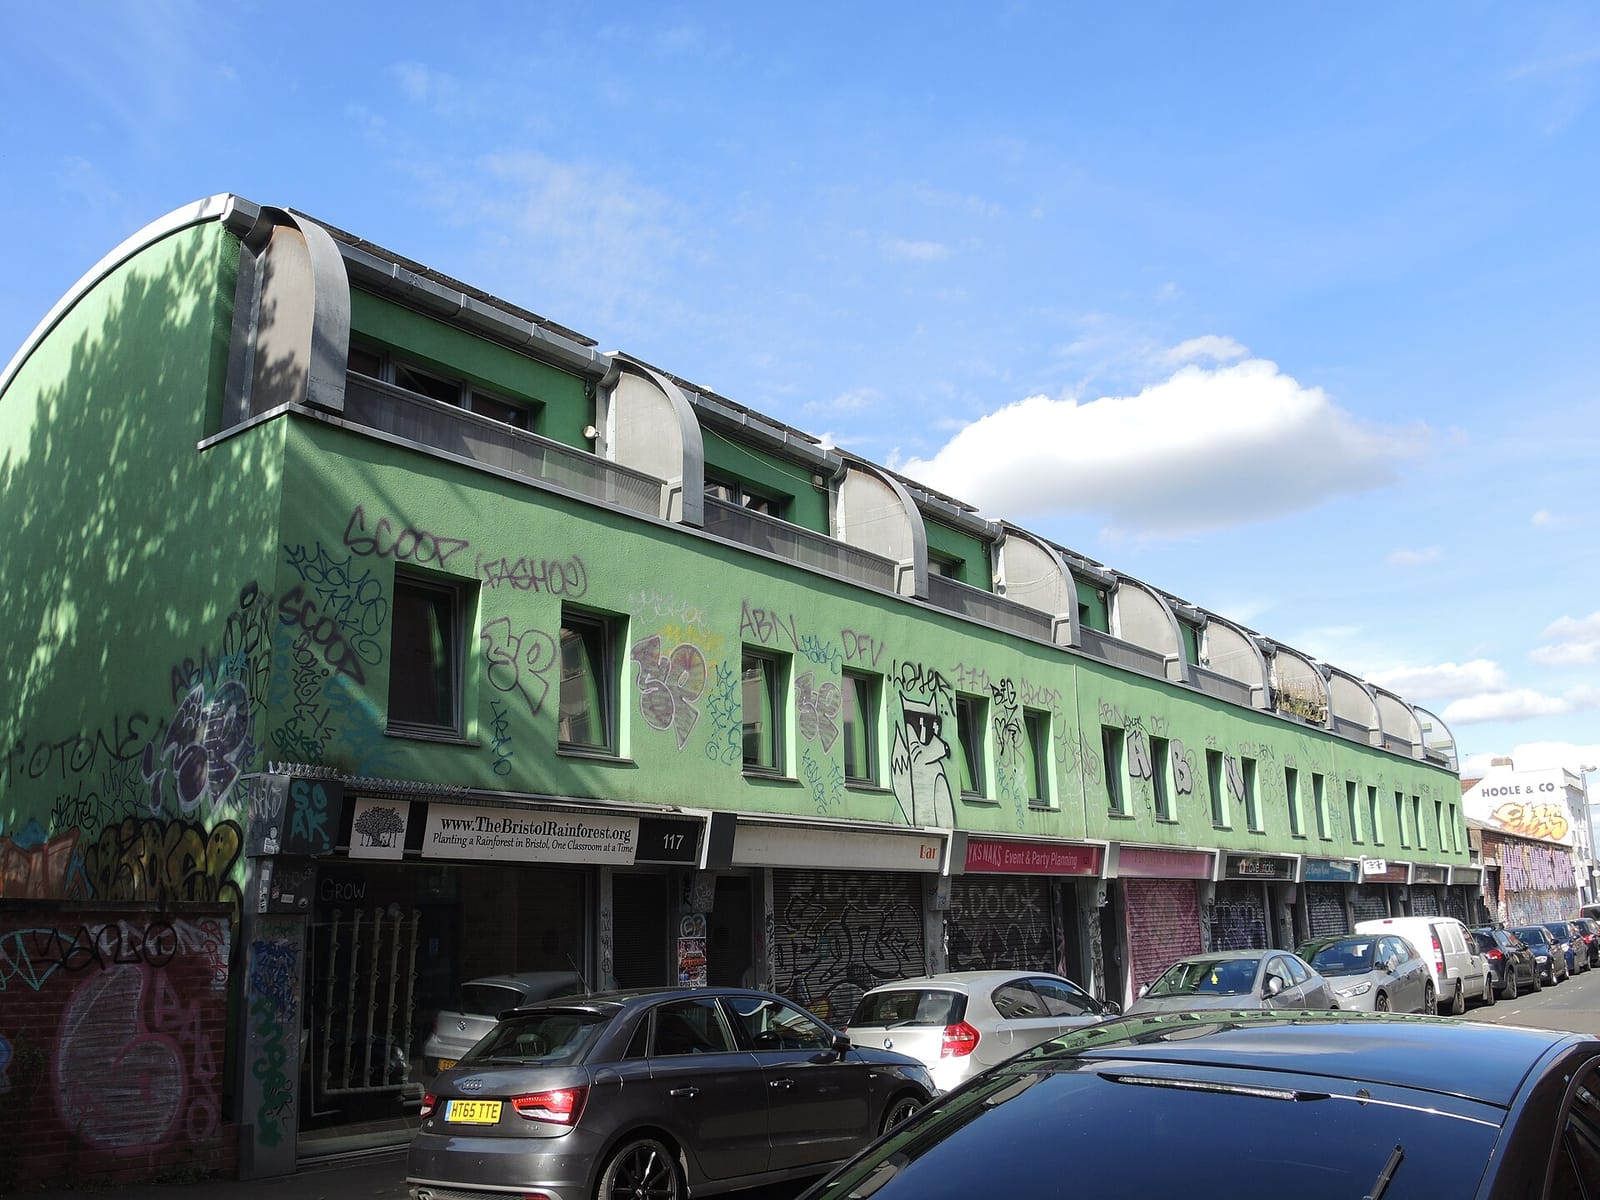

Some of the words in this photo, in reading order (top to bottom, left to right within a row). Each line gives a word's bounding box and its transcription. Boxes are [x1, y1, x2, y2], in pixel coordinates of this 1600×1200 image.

[739, 600, 801, 652] ABN
[1481, 785, 1521, 798] HOOLE
[1525, 785, 1534, 794] &
[1538, 782, 1555, 793] CO
[440, 815, 632, 843] www.TheBristolRainforest.org
[432, 832, 468, 849] Planting
[468, 838, 474, 846] a
[475, 835, 515, 850] Rainforest
[515, 839, 524, 848] in
[551, 839, 567, 850] One
[567, 840, 602, 851] Classroom
[602, 843, 611, 852] at
[617, 843, 634, 853] Time
[662, 833, 684, 851] 117
[1004, 849, 1025, 865] Event
[1025, 850, 1031, 863] &
[1031, 852, 1050, 869] Party
[1050, 852, 1078, 869] Planning
[451, 1103, 476, 1118] HT65
[479, 1103, 499, 1119] TTE
